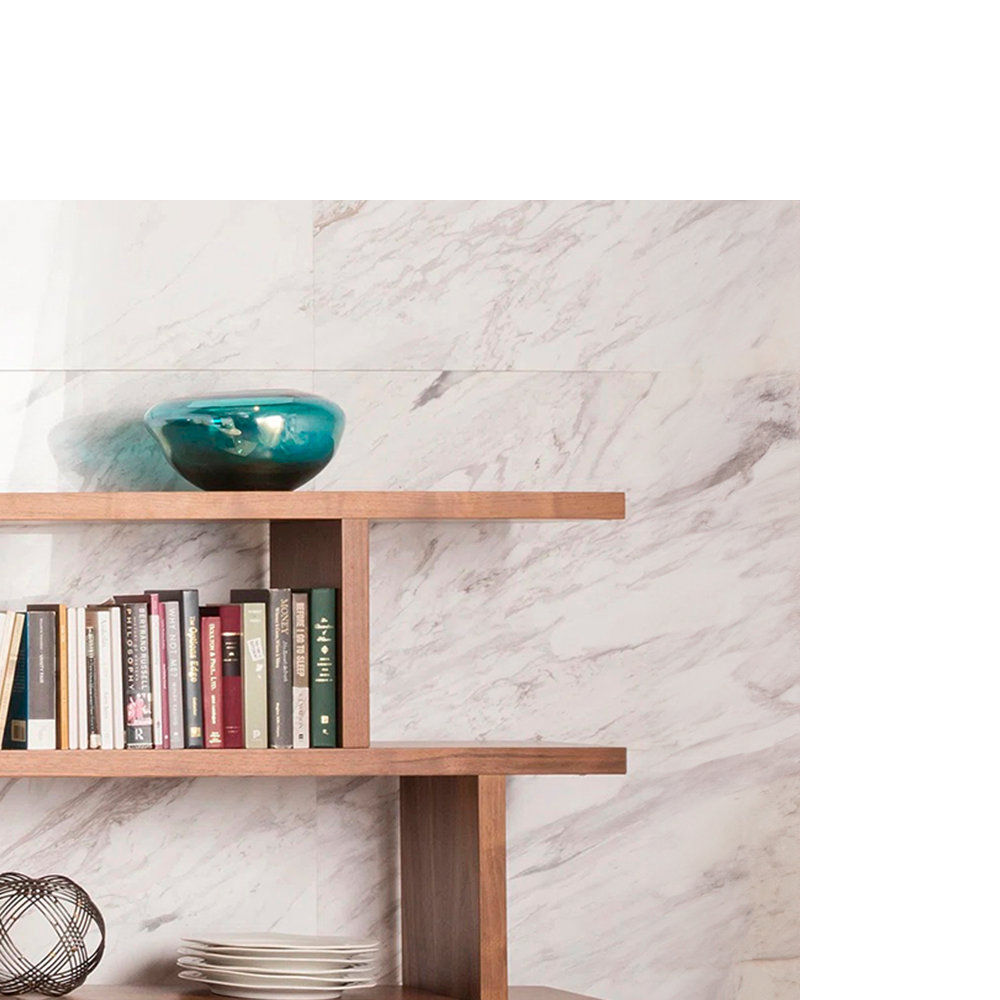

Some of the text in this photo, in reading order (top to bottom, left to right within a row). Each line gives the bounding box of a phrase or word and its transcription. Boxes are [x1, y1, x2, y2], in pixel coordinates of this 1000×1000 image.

[280, 598, 290, 635] MONEY
[295, 602, 305, 627] BEFORE
[126, 608, 136, 690] PHILOSOPHY
[138, 607, 149, 690] BERTRAND RUSSELL
[168, 607, 178, 677] WHY NOT ME?
[187, 626, 198, 658] Options
[296, 633, 305, 644] GO
[296, 645, 305, 654] TO
[189, 660, 199, 683] Edge
[296, 655, 306, 677] SLEEP
